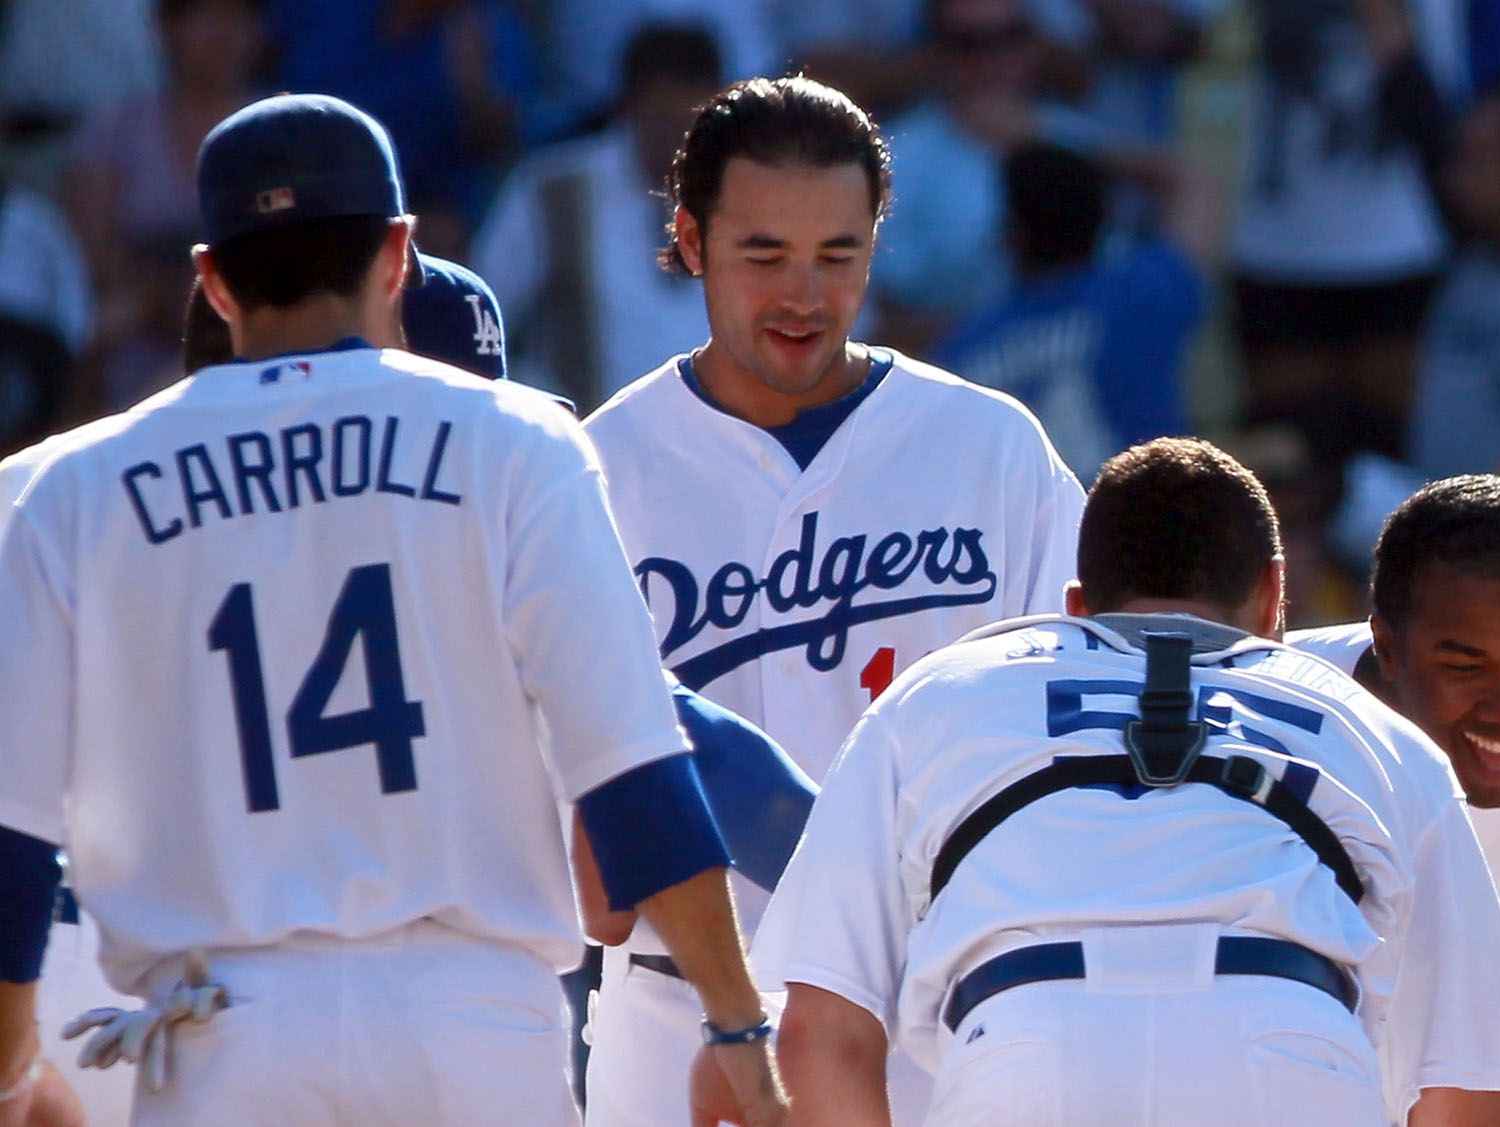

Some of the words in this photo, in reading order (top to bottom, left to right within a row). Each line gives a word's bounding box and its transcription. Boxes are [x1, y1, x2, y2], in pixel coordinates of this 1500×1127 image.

[464, 294, 502, 356] LA
[120, 414, 462, 546] CARROLL
[633, 510, 998, 690] Dodgers
[207, 562, 427, 814] 14
